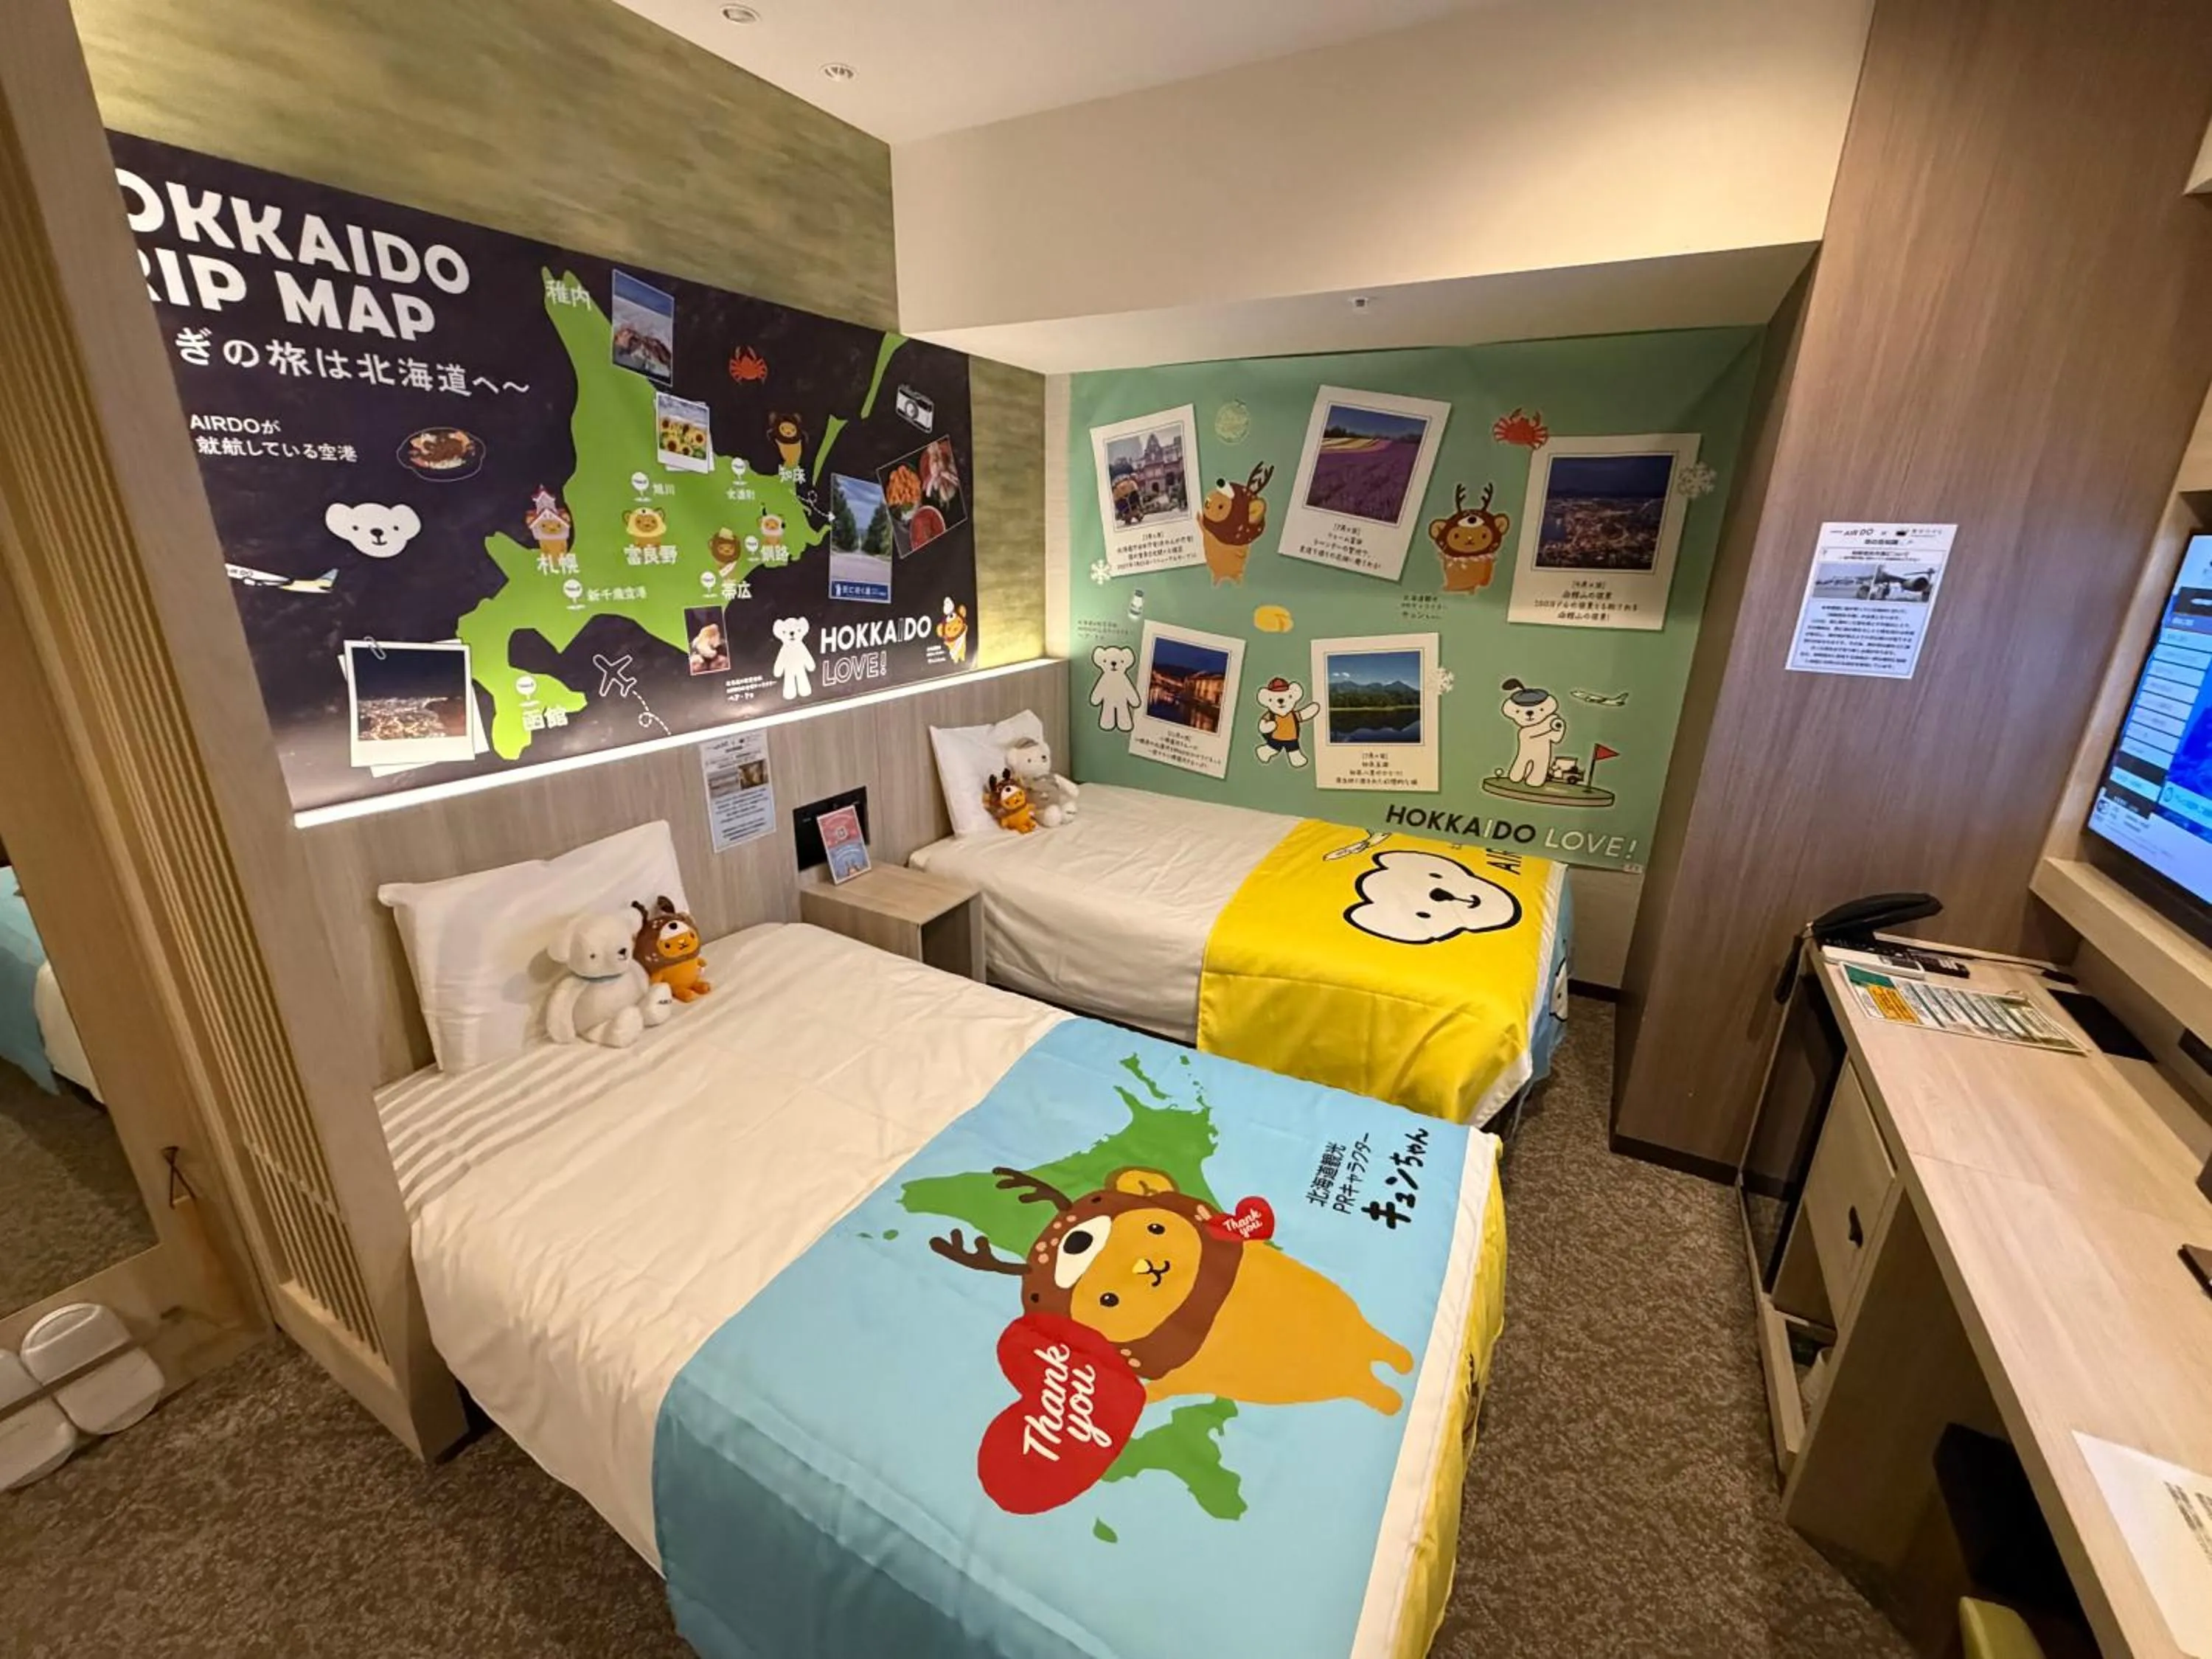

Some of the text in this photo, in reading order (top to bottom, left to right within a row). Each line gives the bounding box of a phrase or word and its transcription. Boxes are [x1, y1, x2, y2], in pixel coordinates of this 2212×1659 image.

[115, 167, 470, 295] OKKAIDO
[275, 271, 436, 341] MAP
[545, 280, 591, 311] 稚内
[189, 414, 282, 434] AIRDOが
[195, 435, 358, 462] 就航している空港
[778, 465, 807, 484] 知床
[537, 553, 580, 576] 札幌
[624, 544, 678, 566] 富良野
[721, 580, 753, 600] 帯広
[820, 615, 933, 655] HOKKAIDO
[822, 650, 888, 687] LOVE!
[522, 705, 568, 731] 函館
[1385, 804, 1638, 860] HOKKAIDO LOVE!
[1306, 1141, 1347, 1208] 北海道観光
[1332, 1132, 1370, 1214] PRキャラクター
[1361, 1127, 1430, 1230] キュンちゃん
[1222, 1208, 1262, 1231] Thank
[1239, 1220, 1263, 1238] you
[1022, 1343, 1071, 1461] Thank
[1066, 1364, 1113, 1448] you
